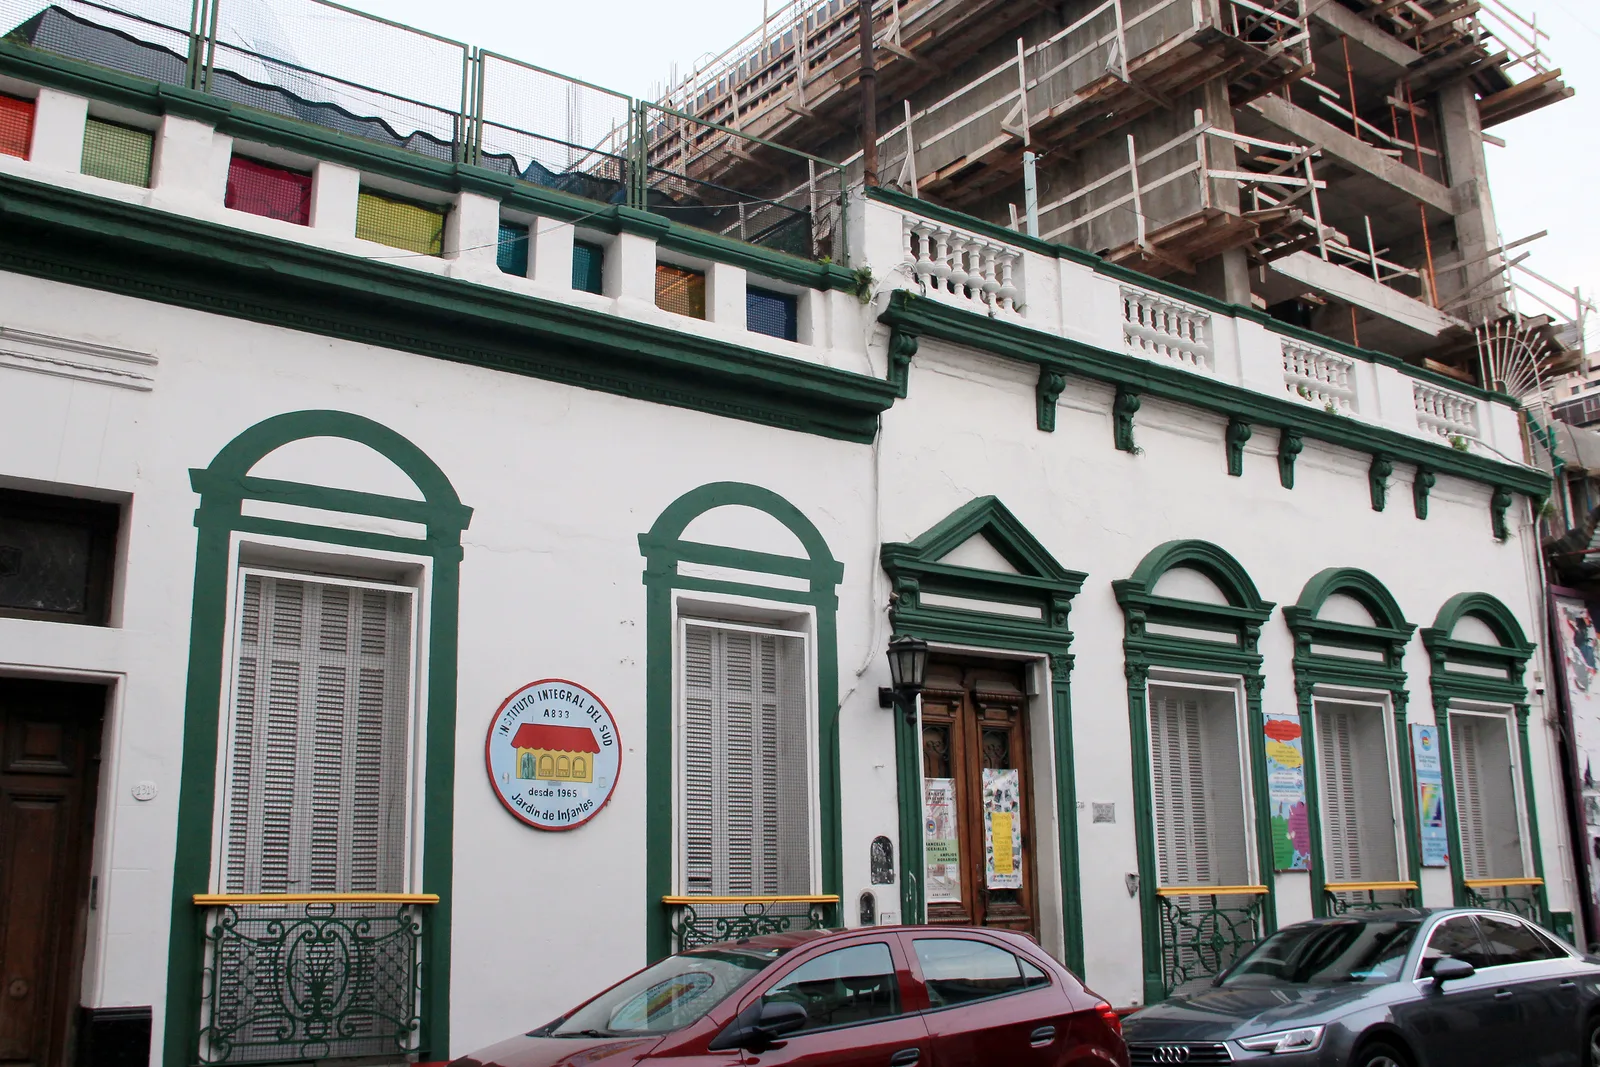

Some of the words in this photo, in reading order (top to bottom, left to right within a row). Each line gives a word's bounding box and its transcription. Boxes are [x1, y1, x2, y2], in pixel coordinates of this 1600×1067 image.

[498, 694, 535, 737] INSTITUTO
[538, 689, 585, 708] INTEGRAL
[586, 705, 601, 723] DEL
[599, 724, 613, 747] SUD
[543, 709, 570, 719] A833
[529, 787, 553, 797] desde
[557, 788, 578, 798] 1965
[542, 809, 555, 820] de
[557, 798, 594, 822] Infantes
